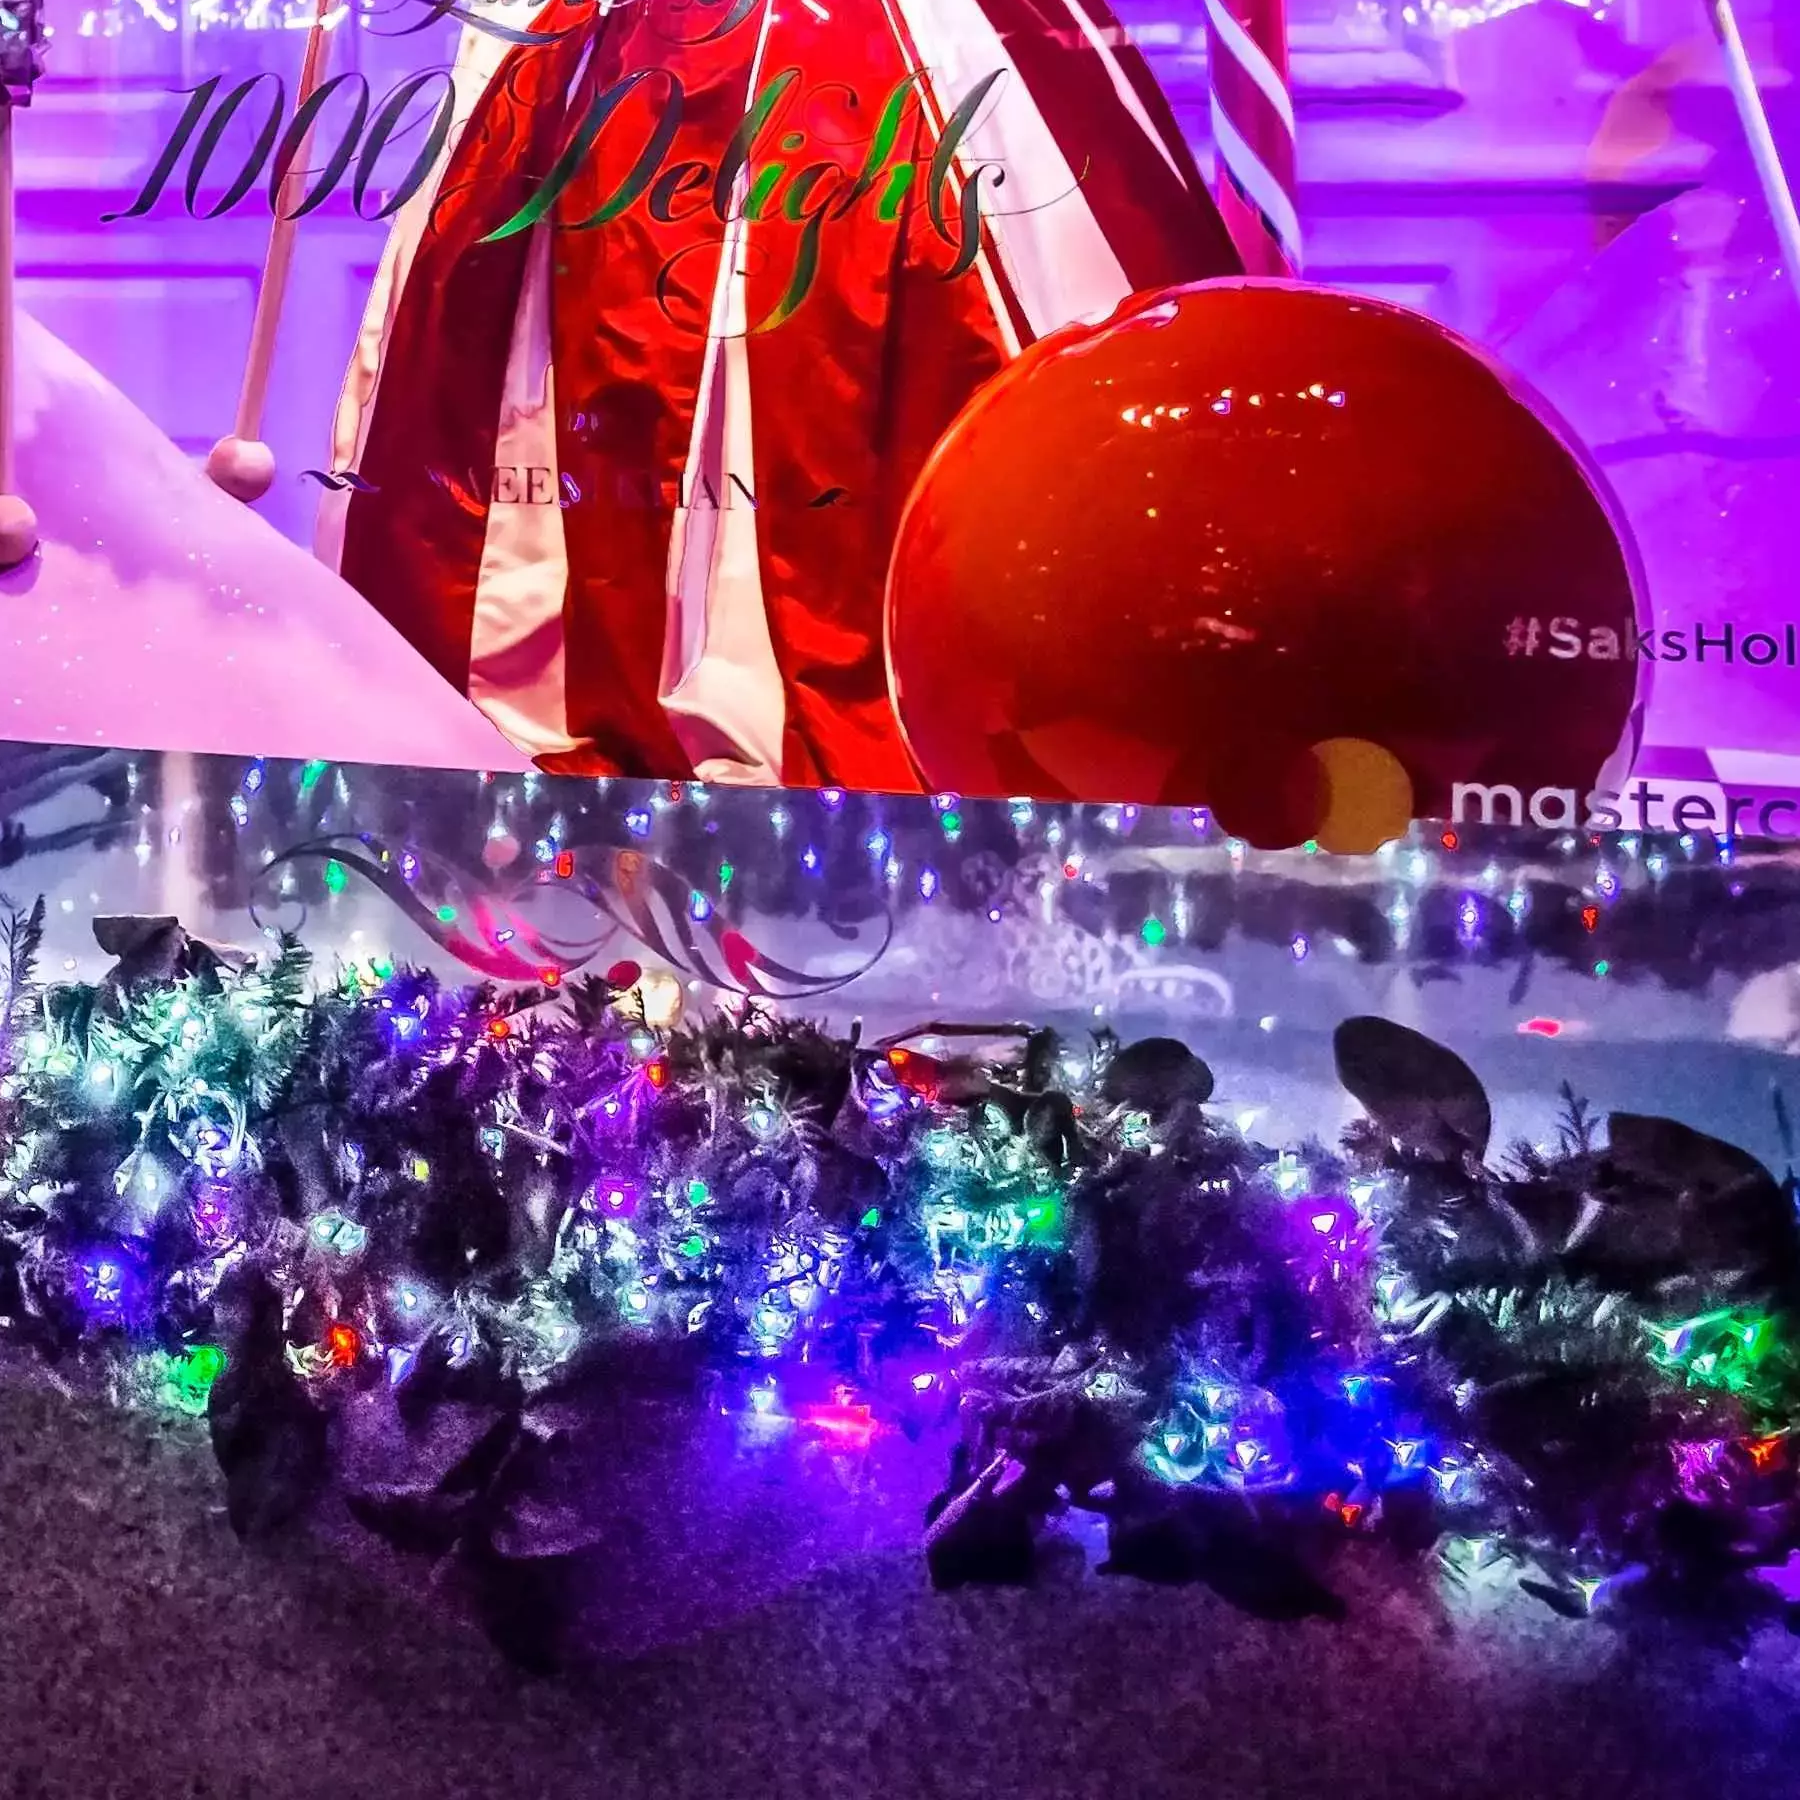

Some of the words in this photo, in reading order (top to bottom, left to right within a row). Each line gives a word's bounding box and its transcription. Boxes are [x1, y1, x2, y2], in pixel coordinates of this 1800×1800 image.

[97, 66, 462, 224] 1000
[436, 64, 1092, 340] Delights
[1502, 615, 1800, 667] #SaksHol
[1451, 780, 1800, 840] masterc
